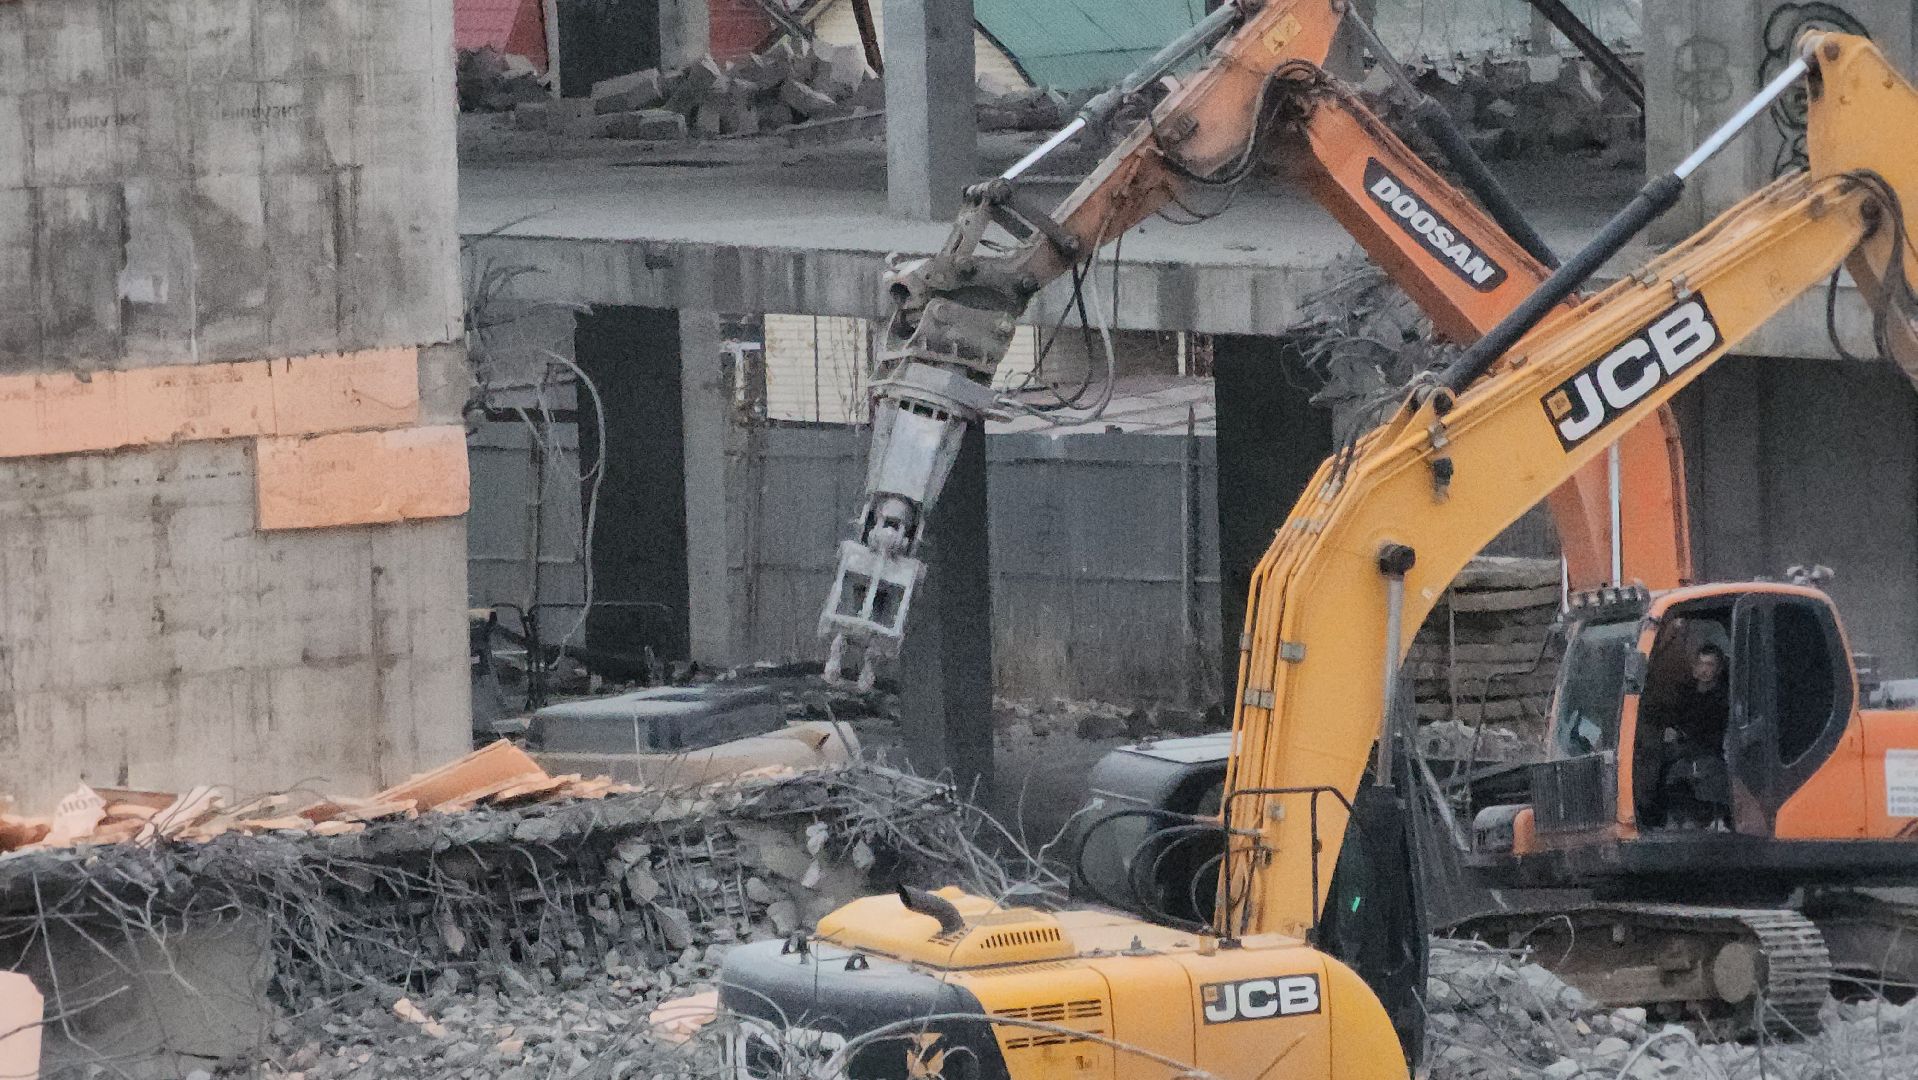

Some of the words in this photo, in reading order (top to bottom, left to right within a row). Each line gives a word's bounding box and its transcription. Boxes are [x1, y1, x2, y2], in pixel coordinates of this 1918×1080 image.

[1371, 176, 1496, 284] DOOSAN
[1558, 301, 1716, 441] JCB
[1205, 976, 1319, 1022] JCB
